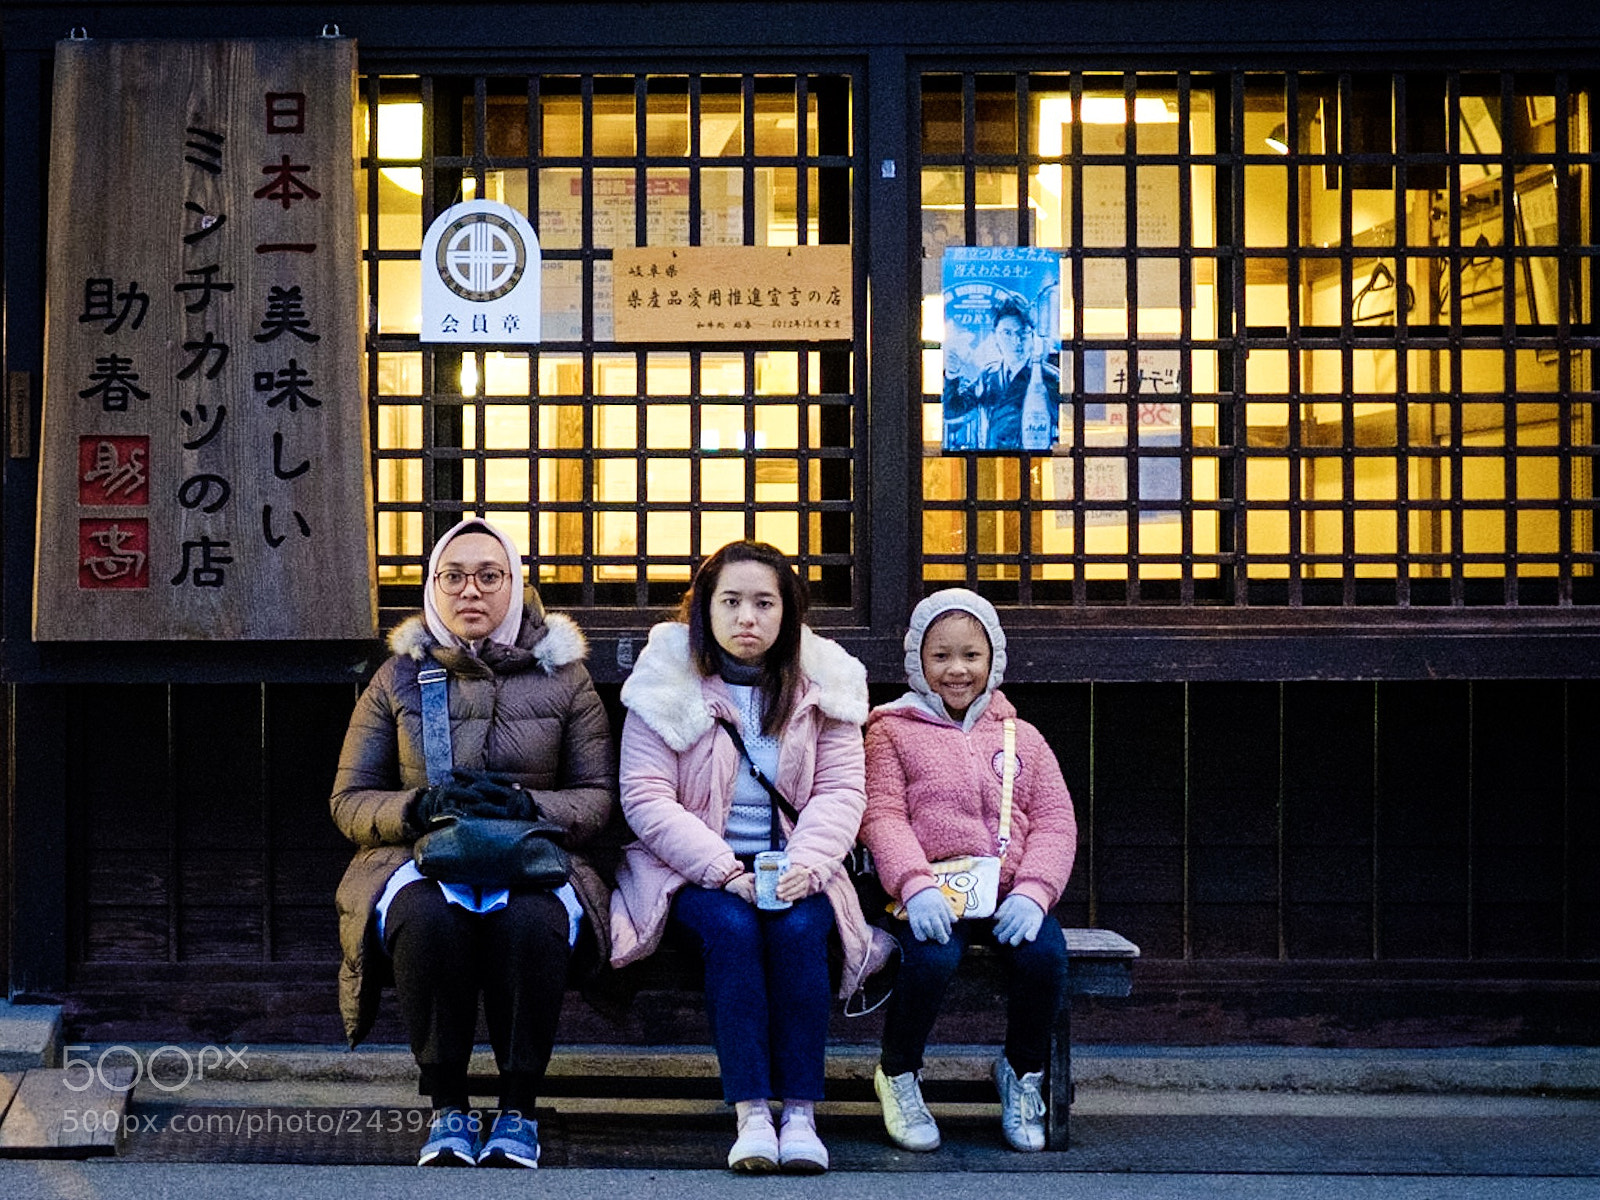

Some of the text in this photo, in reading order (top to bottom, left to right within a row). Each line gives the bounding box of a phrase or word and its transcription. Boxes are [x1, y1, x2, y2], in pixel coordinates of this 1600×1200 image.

[627, 287, 842, 309] 県産品愛用推進宣言の店
[629, 264, 678, 278] 岐阜県
[79, 278, 150, 412] 助春
[171, 127, 234, 587] ミンチカツの店
[253, 91, 321, 548] 日本一美味しい
[441, 314, 520, 333] 会員章
